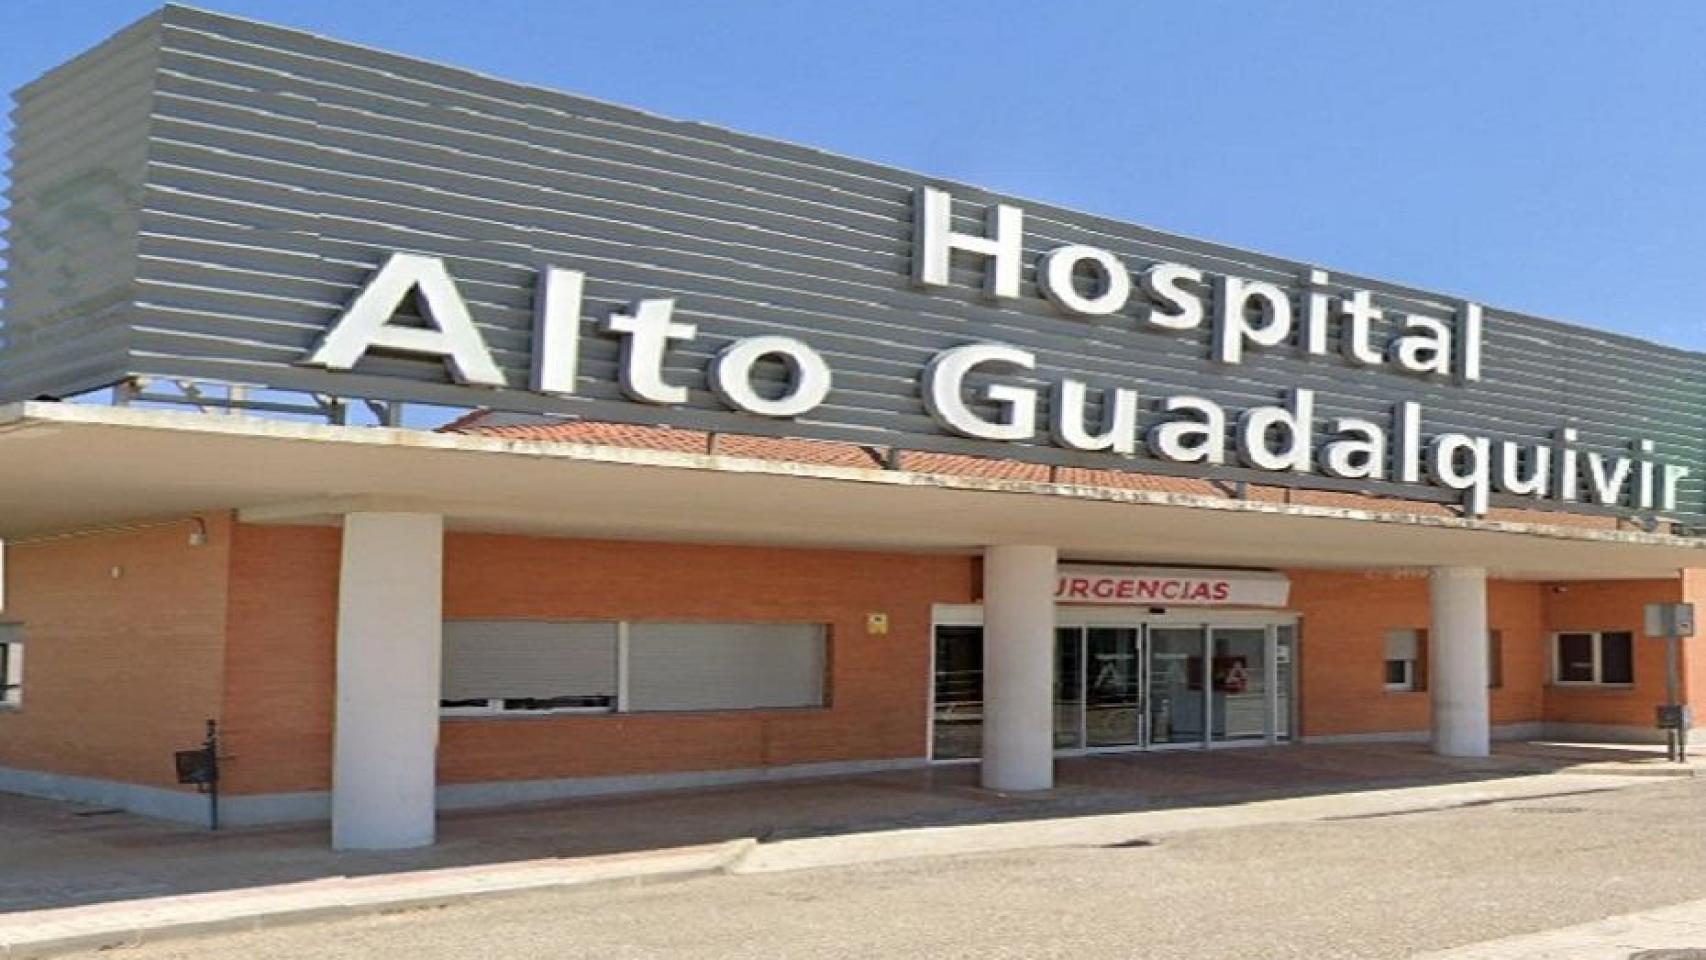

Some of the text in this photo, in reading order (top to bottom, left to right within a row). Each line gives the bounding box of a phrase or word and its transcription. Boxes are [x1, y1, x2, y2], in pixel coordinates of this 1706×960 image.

[309, 251, 1690, 516] Alto Guadalquivir
[914, 186, 1484, 382] Hospital
